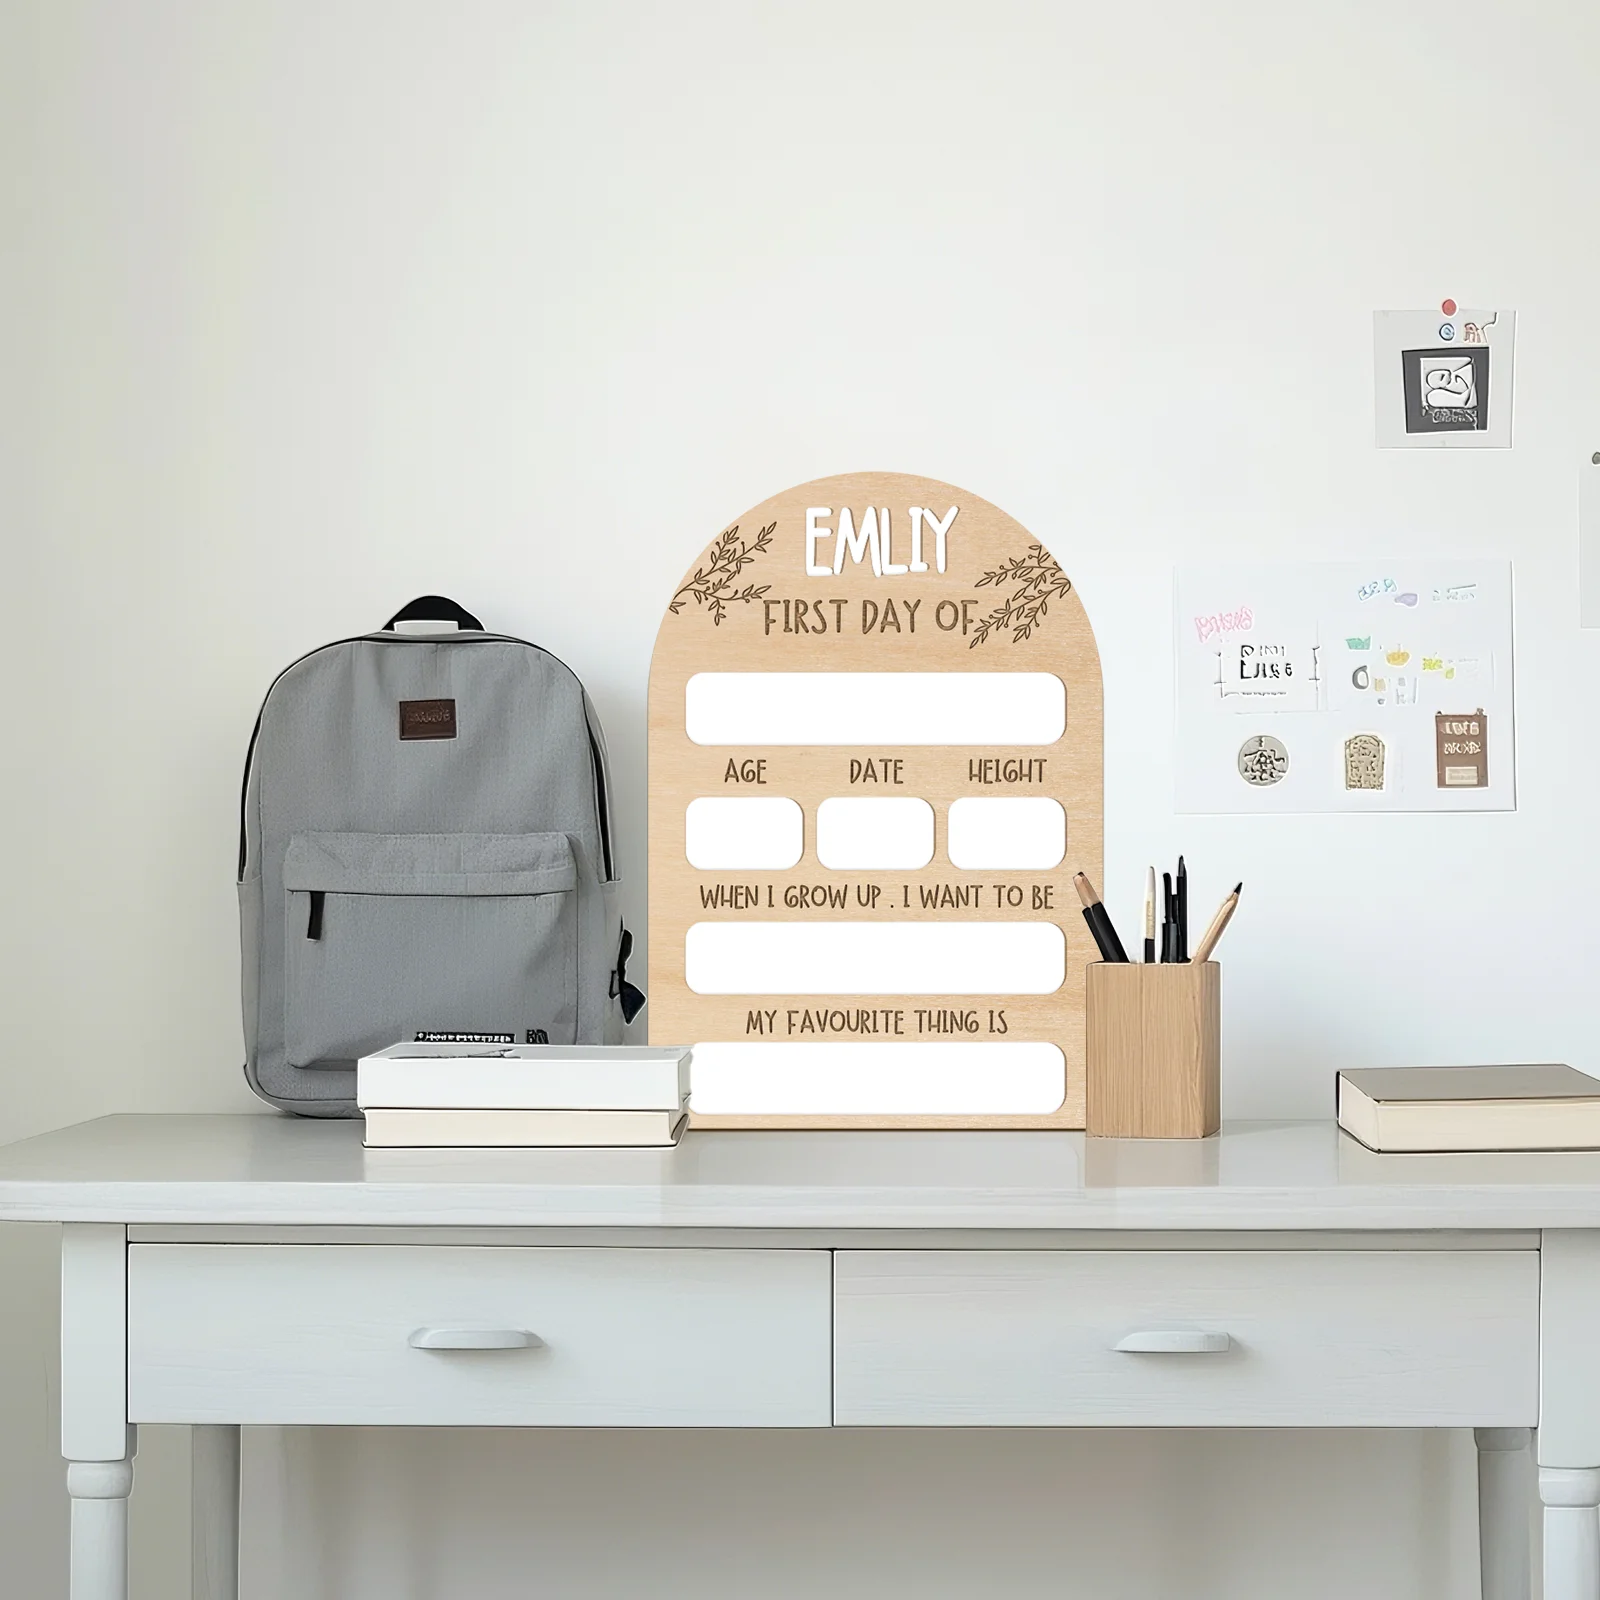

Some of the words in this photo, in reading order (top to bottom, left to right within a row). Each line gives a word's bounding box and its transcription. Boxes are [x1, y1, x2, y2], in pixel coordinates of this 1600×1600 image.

[805, 505, 960, 578] EMLIY
[763, 598, 849, 636] FIRST
[861, 597, 922, 635] DAY
[935, 599, 979, 636] OF
[724, 757, 768, 785] AGE
[849, 757, 905, 785] DATE
[968, 758, 1048, 785] HEIGHT
[699, 883, 760, 910] WHEN
[767, 884, 776, 909] I
[783, 883, 849, 910] GROW
[902, 884, 912, 909] I
[919, 883, 985, 910] WANT
[992, 884, 1025, 910] TO
[1031, 884, 1056, 911] BE
[745, 1009, 779, 1036] MY
[786, 1008, 906, 1036] FAVOURITE
[913, 1009, 981, 1035] THING
[988, 1009, 1009, 1036] IS
